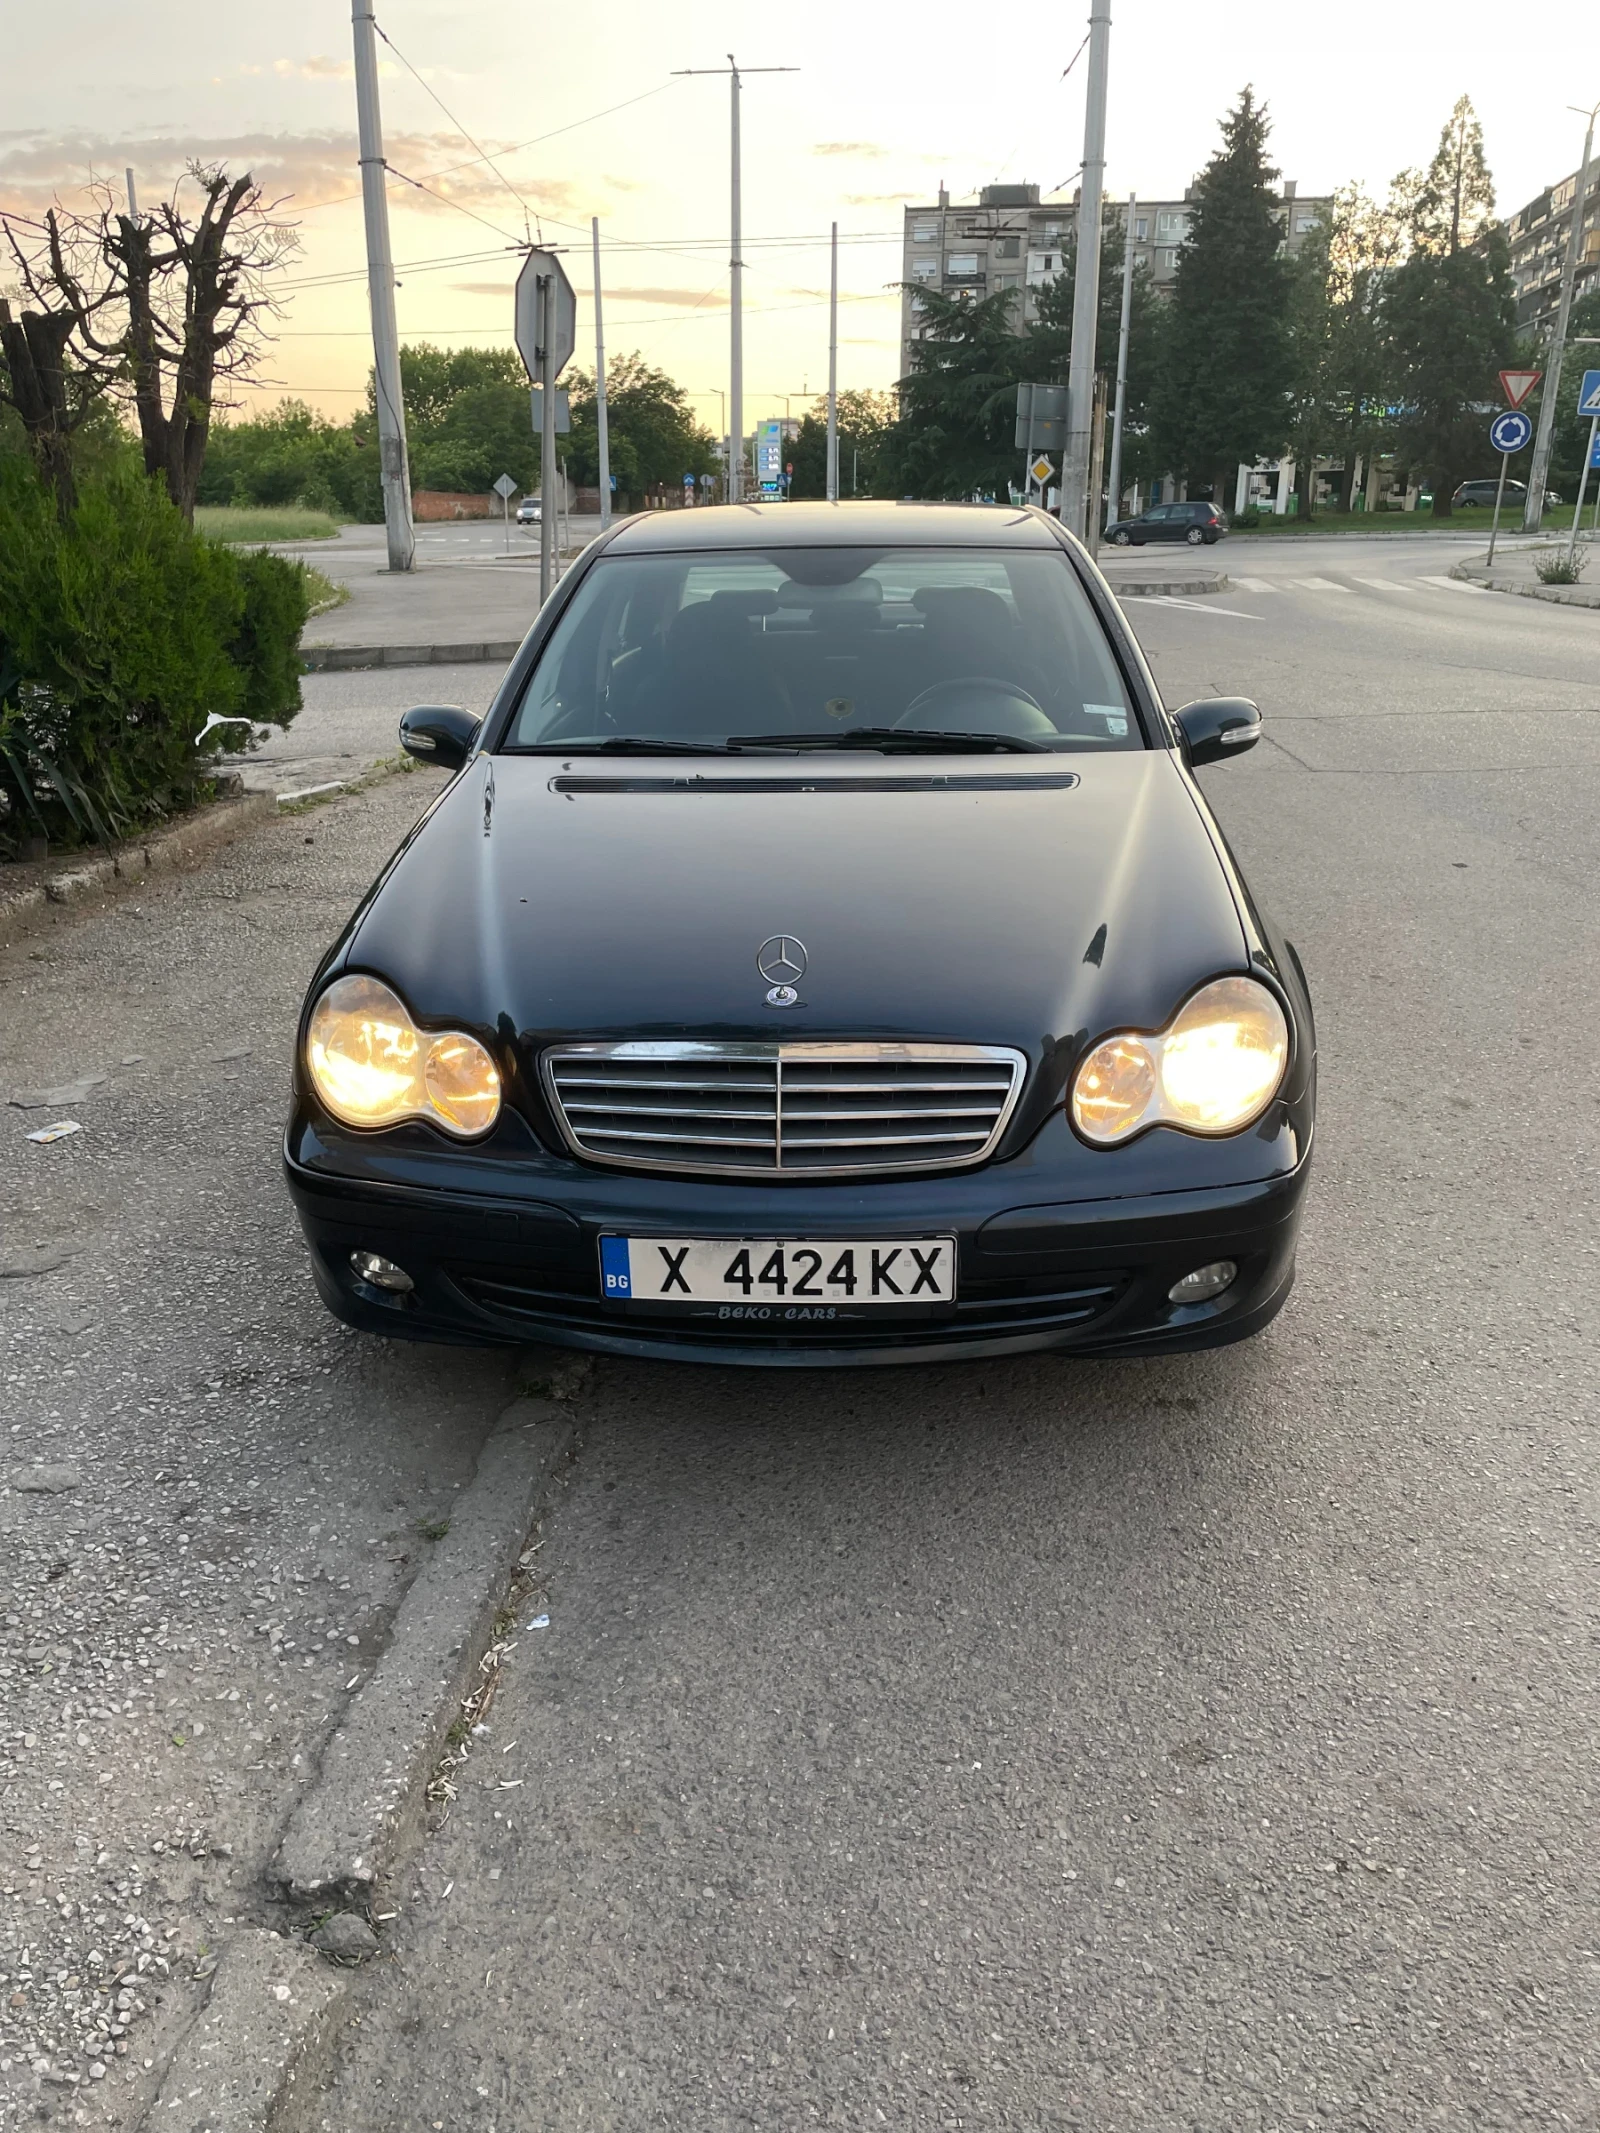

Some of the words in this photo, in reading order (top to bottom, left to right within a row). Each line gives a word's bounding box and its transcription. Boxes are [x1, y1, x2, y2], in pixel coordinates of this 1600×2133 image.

[657, 1246, 692, 1293] X
[606, 1274, 628, 1289] BG
[717, 1306, 772, 1320] BEKO
[784, 1307, 836, 1320] CARS
